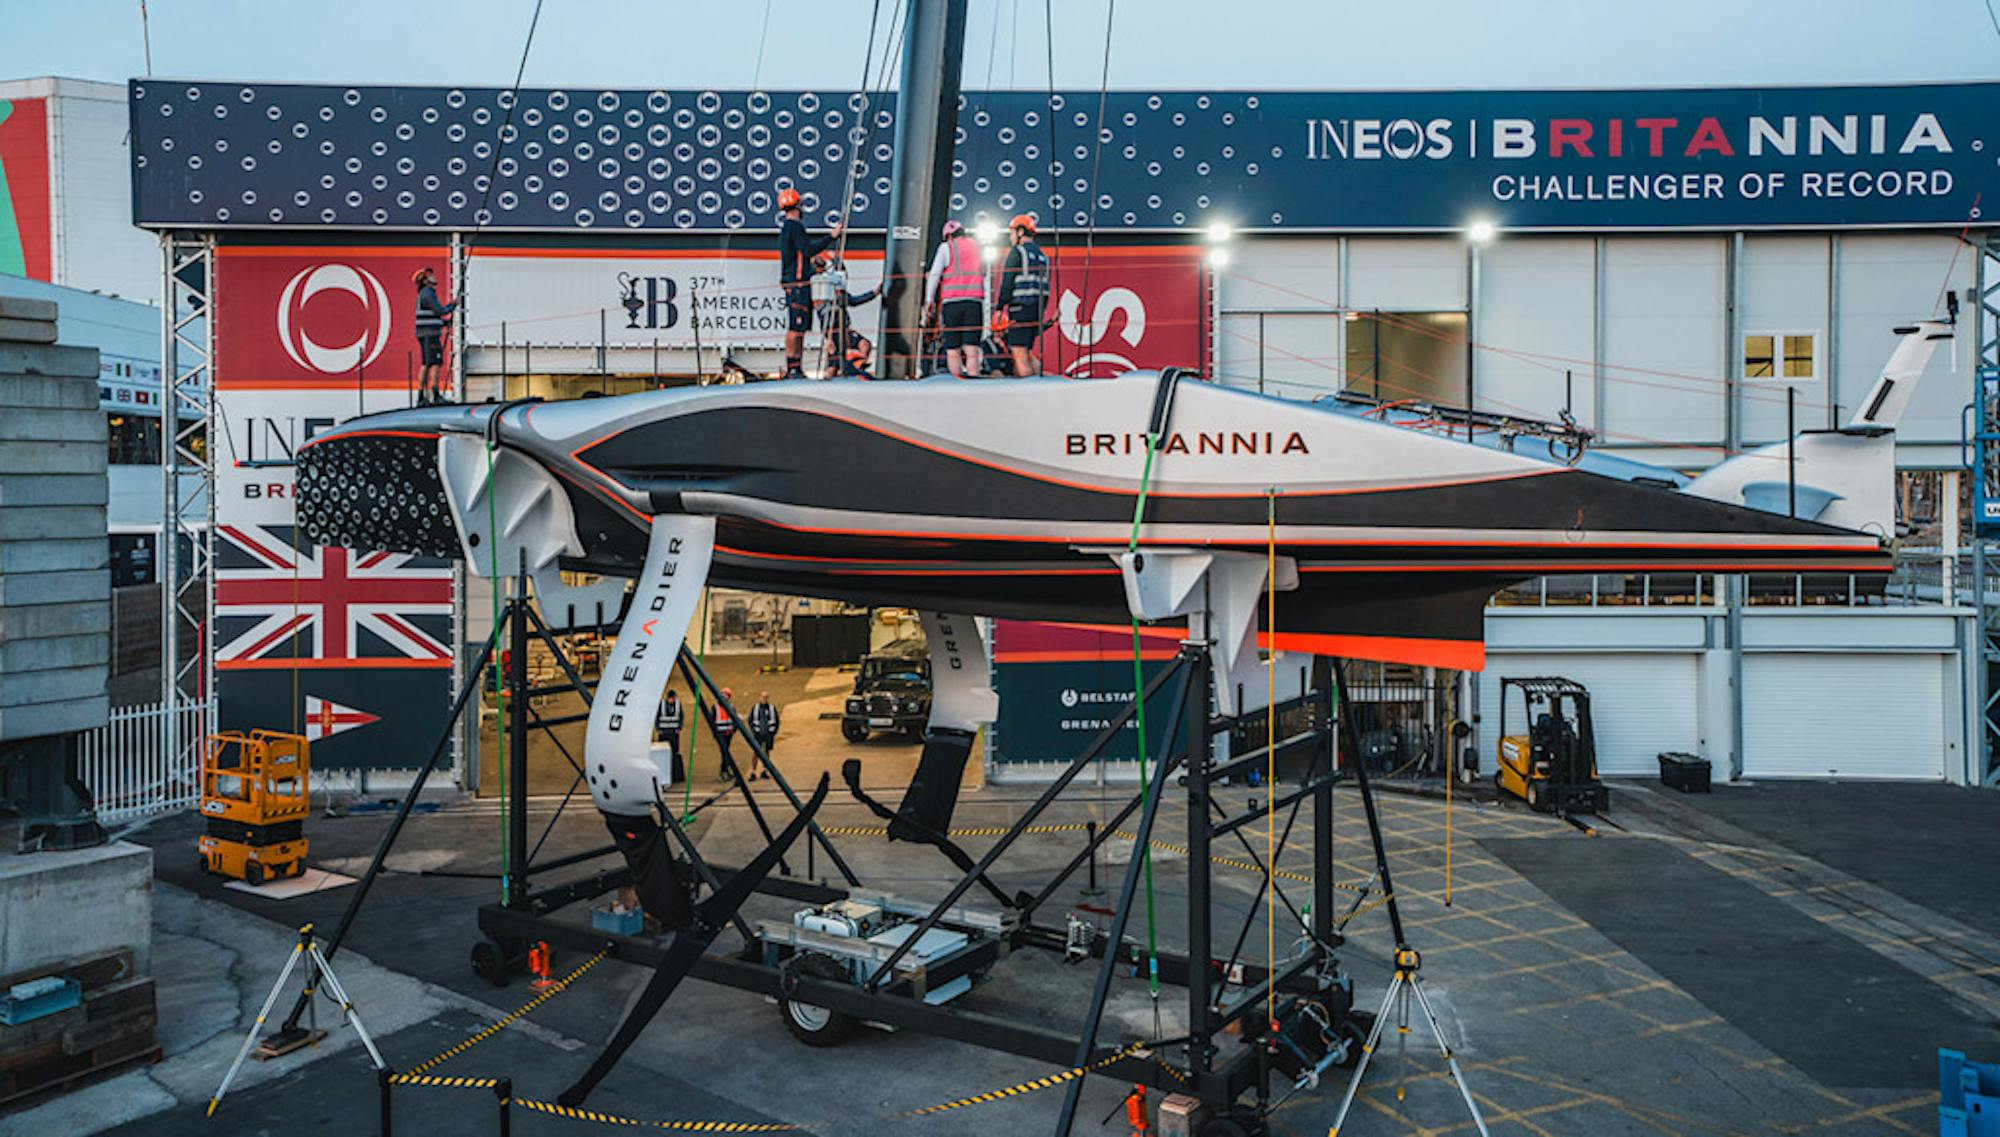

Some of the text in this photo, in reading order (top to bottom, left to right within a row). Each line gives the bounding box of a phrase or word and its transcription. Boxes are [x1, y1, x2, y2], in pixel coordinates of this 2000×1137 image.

[1306, 112, 1954, 160] INEOS BRITANNIA
[1492, 170, 1954, 201] CHALLENGER OF RECORD
[689, 296, 787, 311] AMERICA'S
